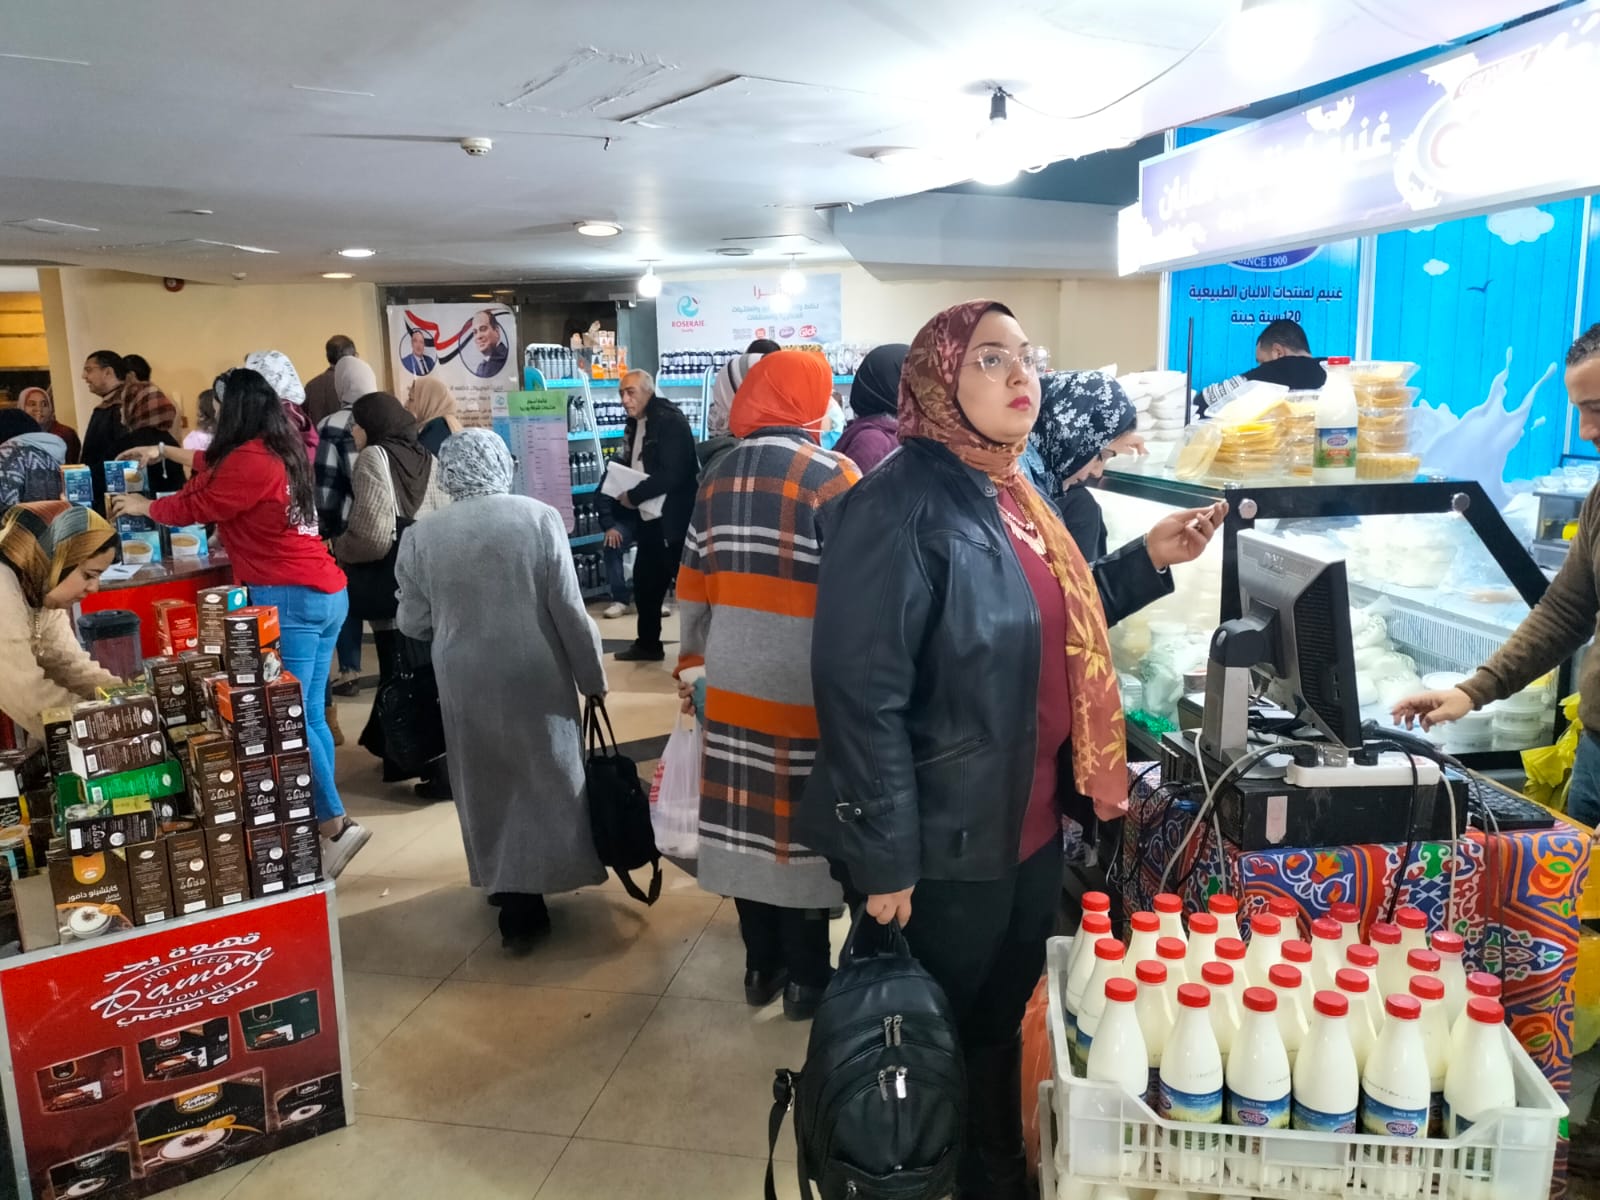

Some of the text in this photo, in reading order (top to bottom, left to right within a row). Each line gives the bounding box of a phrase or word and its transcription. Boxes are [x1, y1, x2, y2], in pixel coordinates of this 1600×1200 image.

[1268, 255, 1288, 266] 1900
[1188, 284, 1237, 301] الطبيعية
[1273, 286, 1314, 301] لمنتجات
[1316, 286, 1344, 303] غنيم
[1231, 311, 1255, 326] جبنة
[168, 931, 261, 958] قهوة
[142, 954, 230, 984] HOT ICED
[168, 987, 209, 1005] LOVE
[211, 981, 226, 991] IT
[116, 980, 259, 1028] منتج طبيعي
